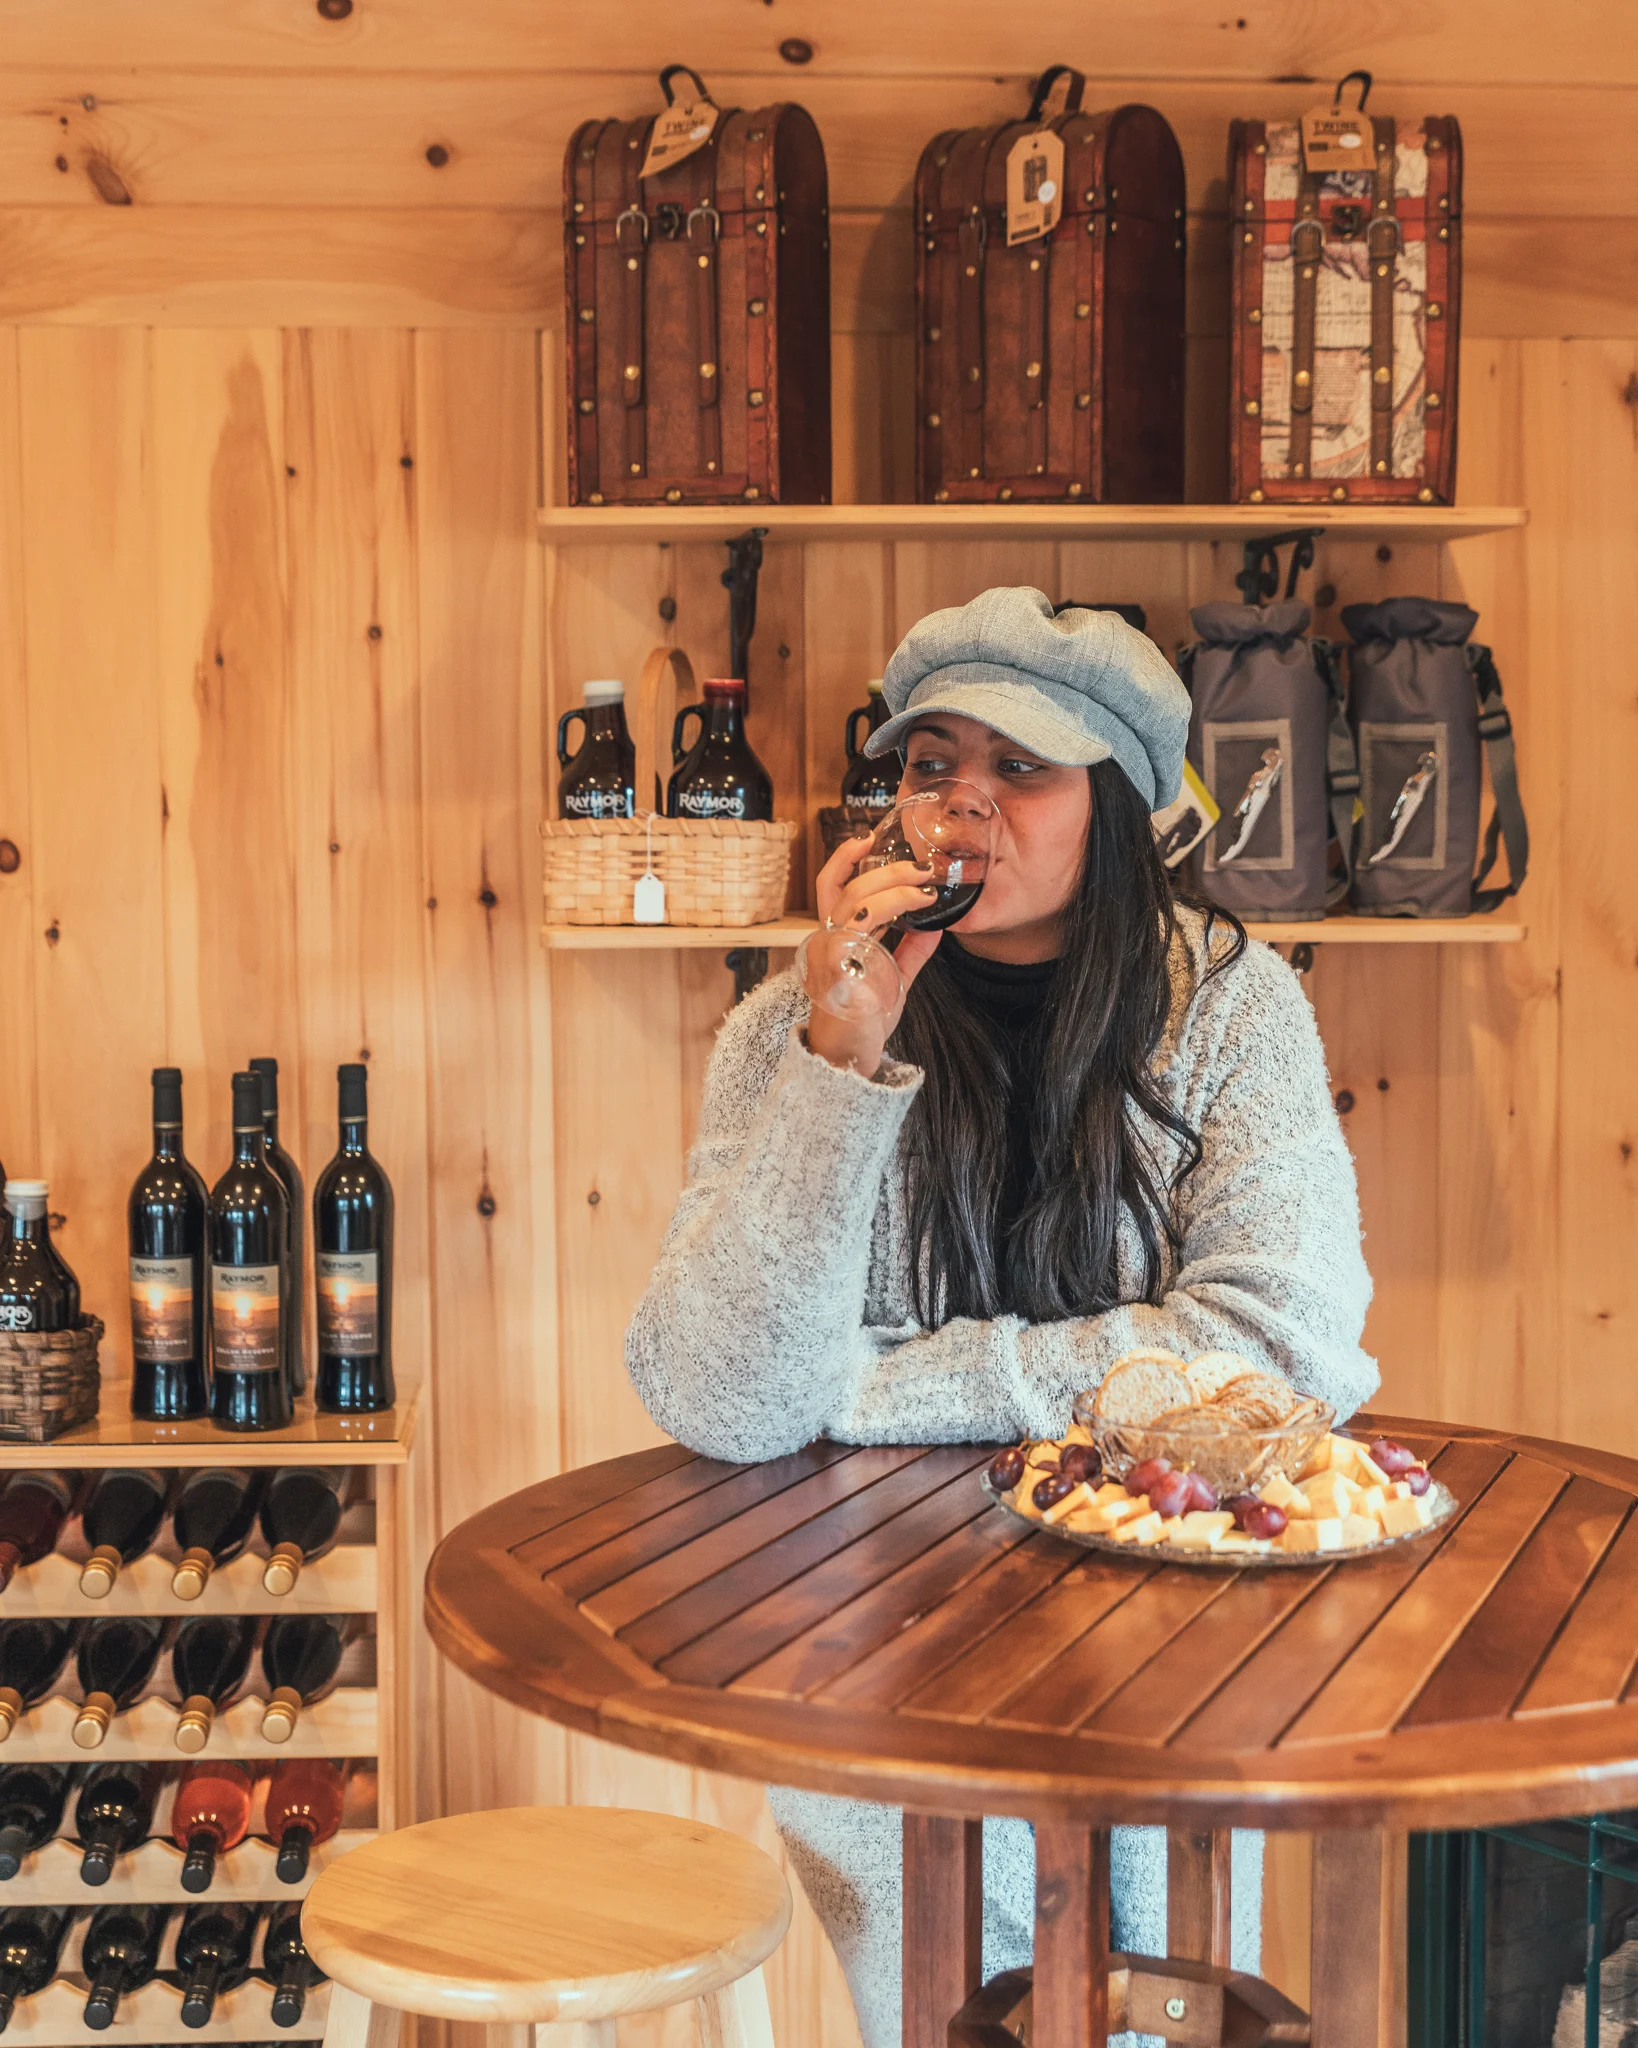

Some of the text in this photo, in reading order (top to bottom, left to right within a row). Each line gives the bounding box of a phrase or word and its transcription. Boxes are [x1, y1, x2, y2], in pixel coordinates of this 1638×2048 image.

[565, 794, 627, 813] RAYMOR
[679, 793, 745, 816] RAYMOR
[221, 1272, 266, 1285] RAYMOR
